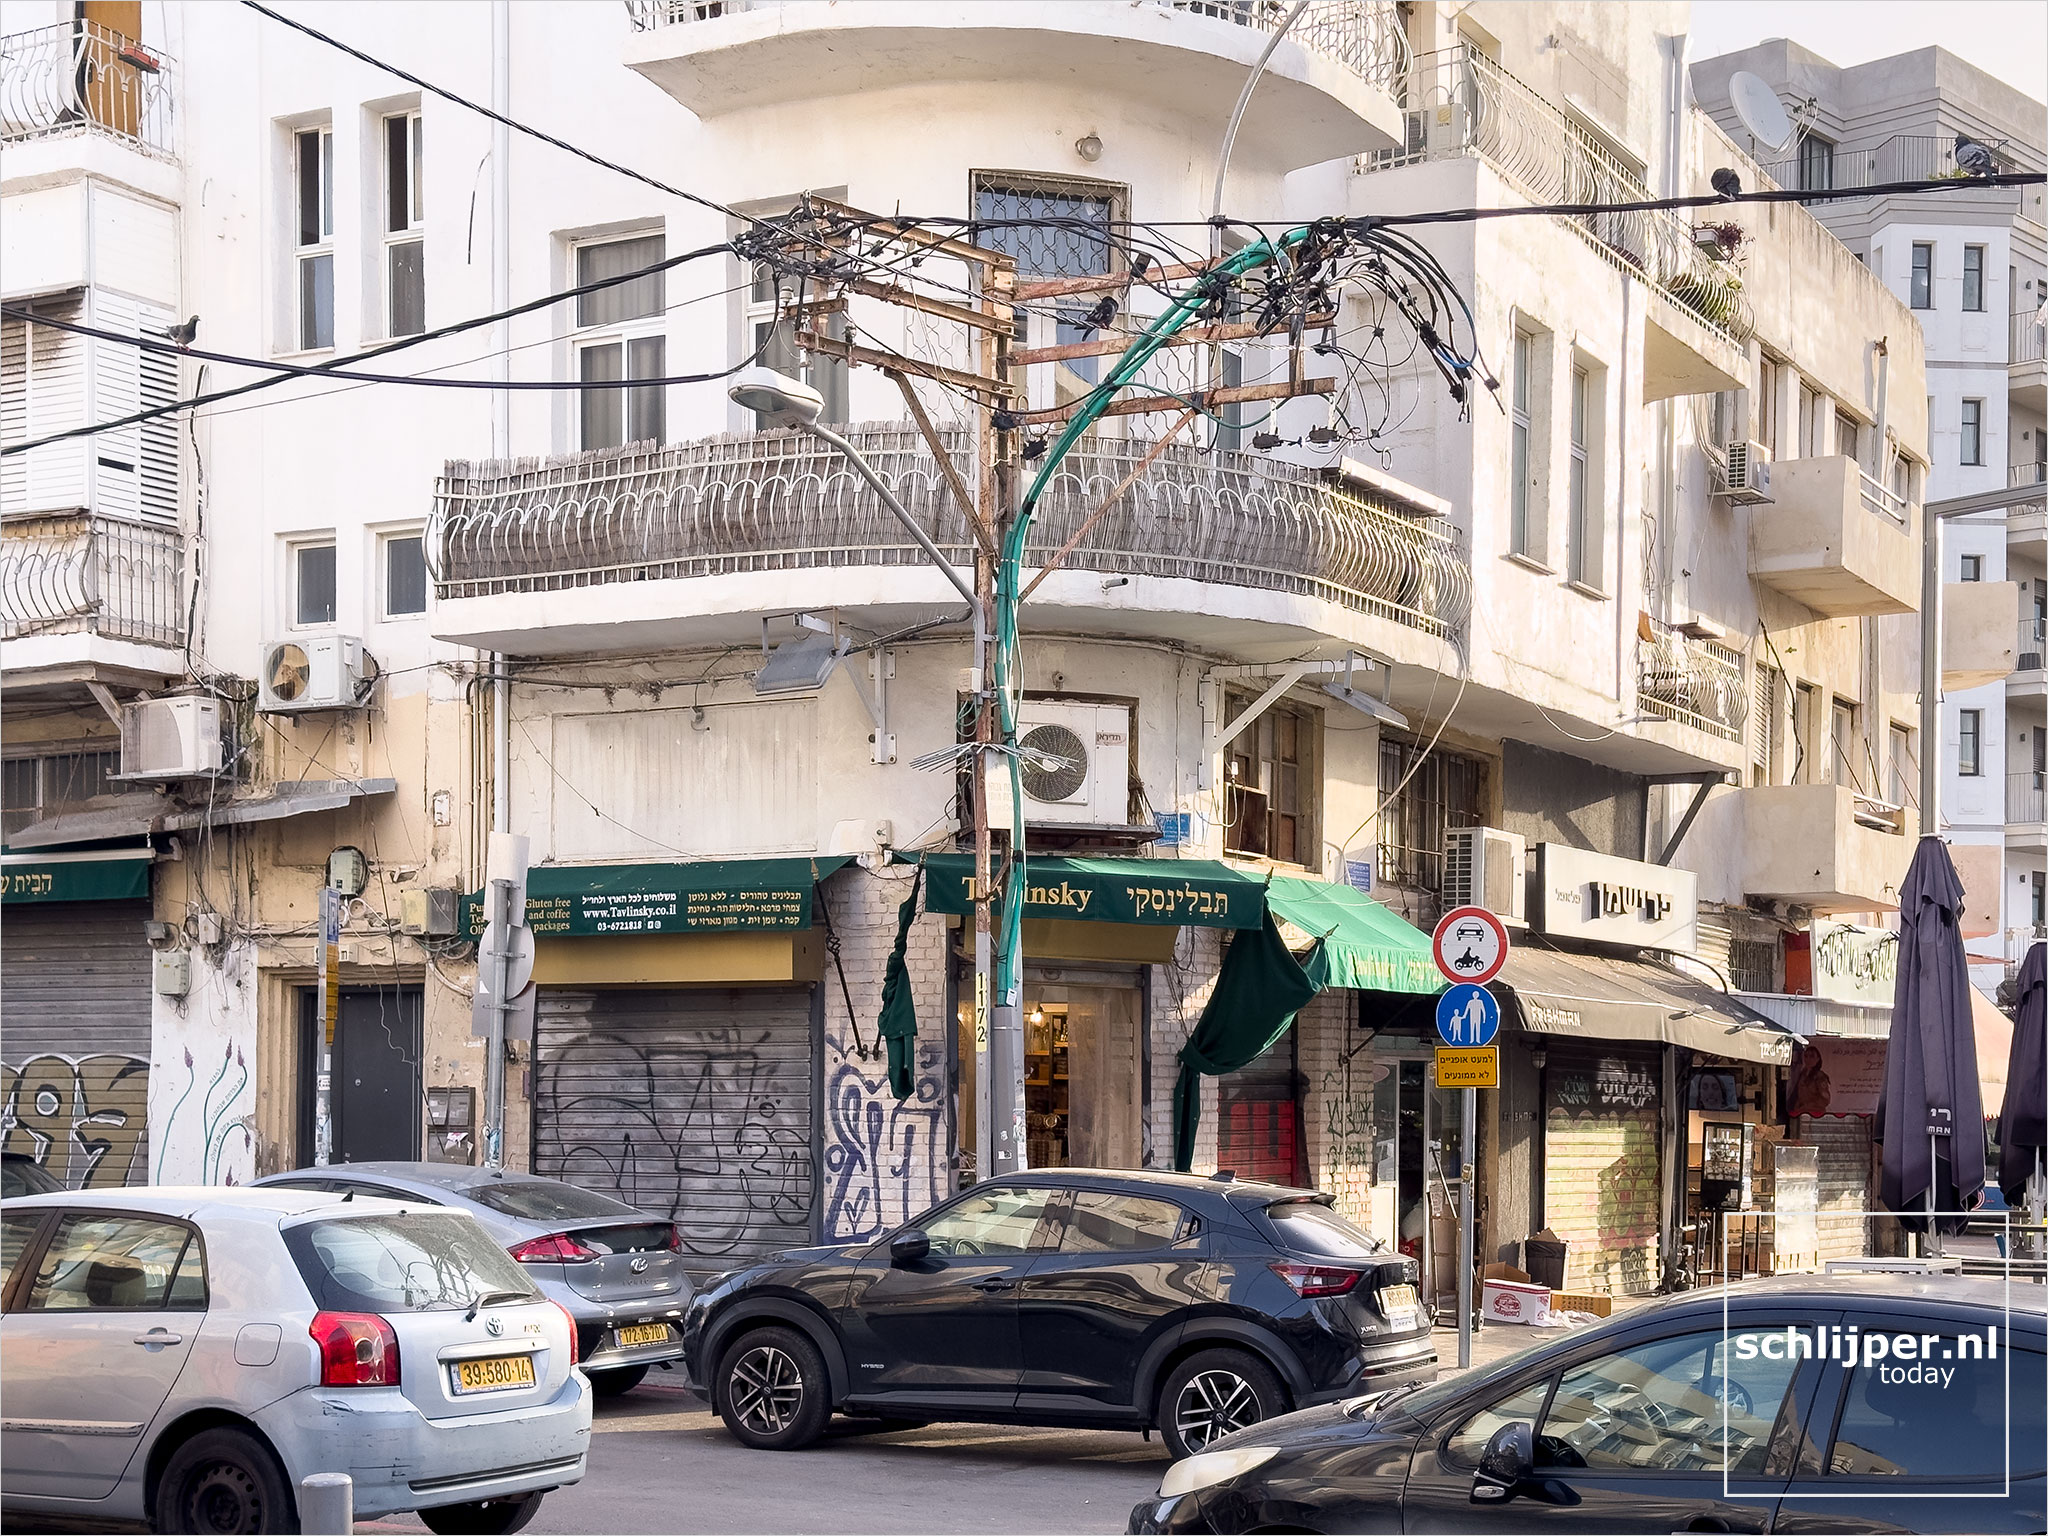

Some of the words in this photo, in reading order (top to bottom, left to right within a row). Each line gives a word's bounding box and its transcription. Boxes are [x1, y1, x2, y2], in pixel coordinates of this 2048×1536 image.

[607, 895, 627, 905] הארץ
[627, 893, 642, 903] לכל
[642, 891, 677, 902] משלוחים
[688, 892, 708, 902] גלוטן
[710, 891, 727, 901] ללא
[740, 891, 769, 900] טהורים
[771, 890, 802, 900] תבלינים
[525, 898, 553, 908] Gluten
[555, 897, 571, 907] free
[729, 903, 756, 912] חליטות
[782, 903, 801, 912] צמחי
[582, 903, 677, 918] www.Tavlinsky.co.il
[687, 905, 711, 914] טחינת
[716, 904, 729, 913] תה
[760, 903, 781, 913] מרפא
[528, 909, 544, 919] and
[546, 908, 571, 919] coffee
[597, 920, 643, 931] 03-6721818
[687, 918, 698, 926] שי
[699, 917, 722, 926] מארזי
[747, 916, 761, 925] זית
[762, 916, 777, 926] שמן
[784, 915, 800, 926] קפה
[533, 920, 571, 933] packages
[1531, 1006, 1581, 1026] FRISHMAN
[1440, 1056, 1469, 1064] אופניים
[1470, 1054, 1493, 1064] למעט
[1444, 1072, 1476, 1080] ממונעים
[1478, 1070, 1490, 1079] לא
